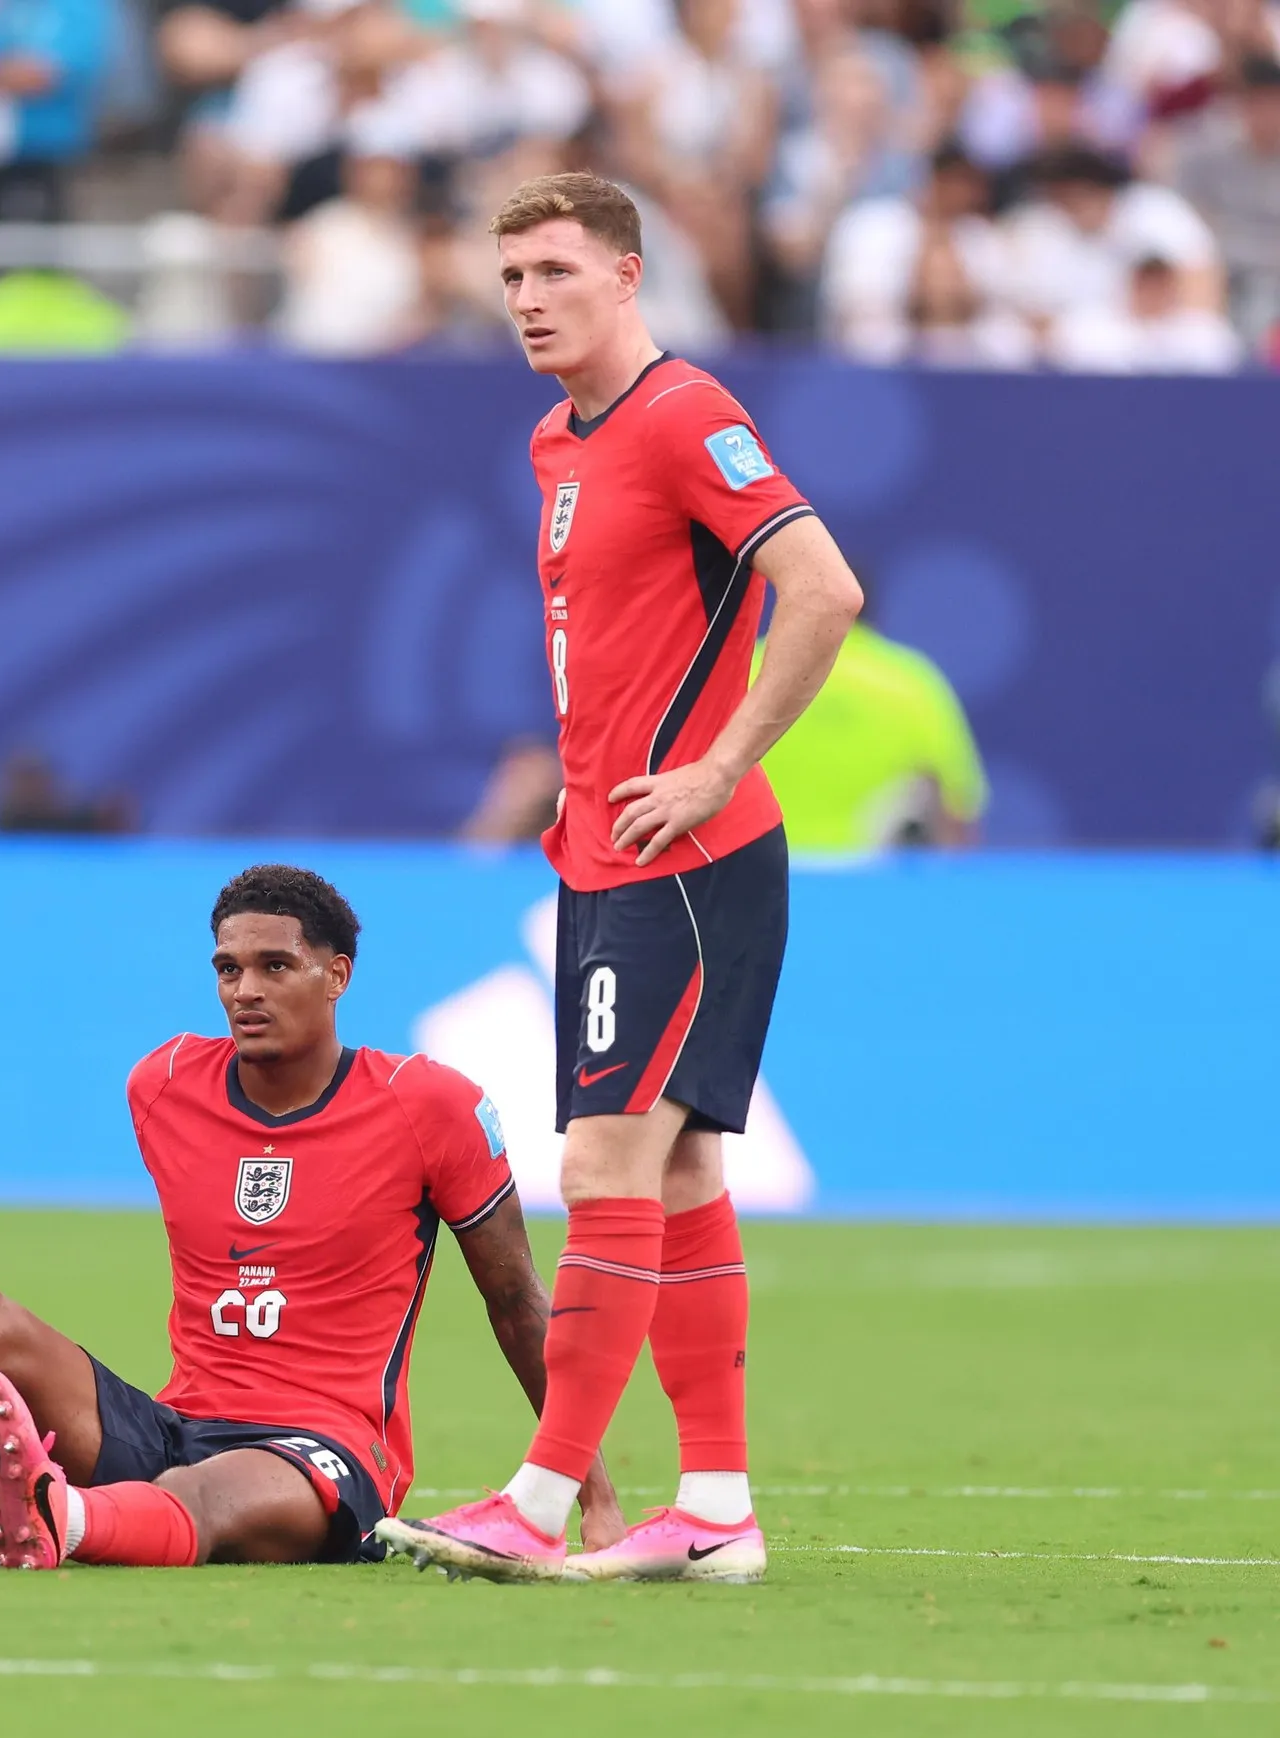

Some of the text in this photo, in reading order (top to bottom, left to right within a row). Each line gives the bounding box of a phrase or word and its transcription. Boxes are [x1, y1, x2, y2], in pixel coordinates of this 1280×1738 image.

[552, 628, 569, 716] 8
[586, 966, 617, 1053] 8
[238, 1265, 276, 1278] PANAMA
